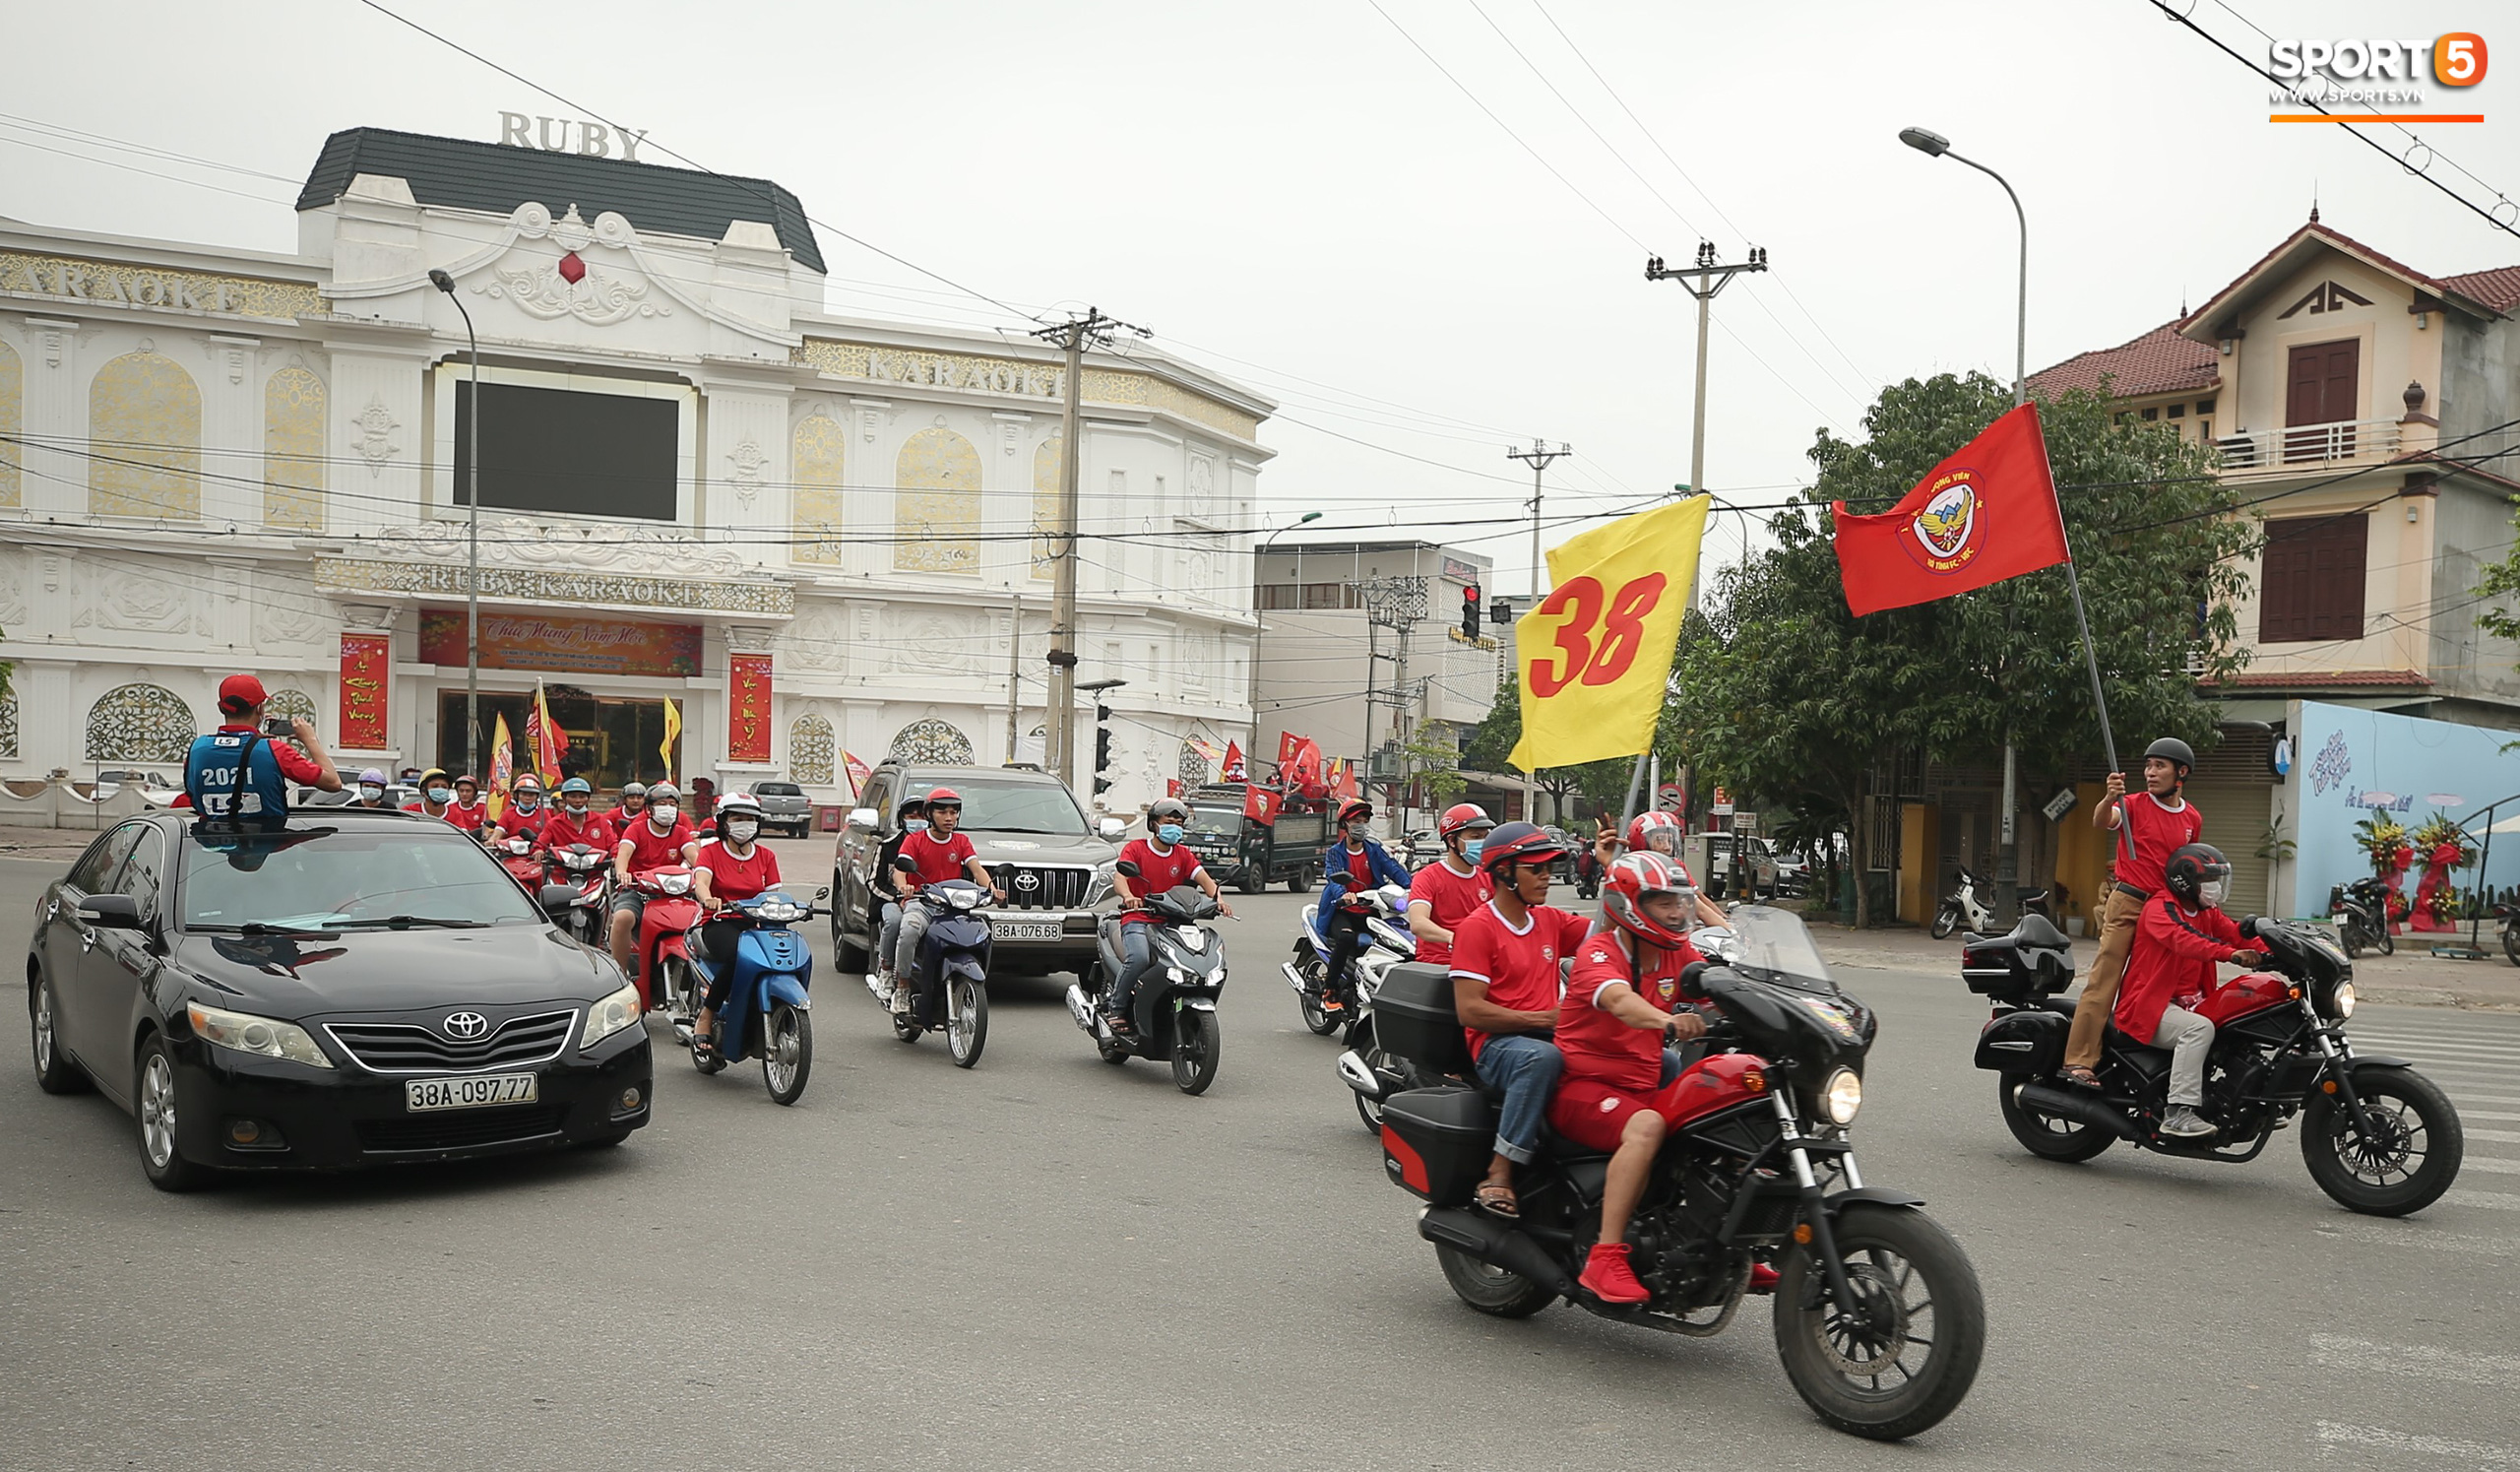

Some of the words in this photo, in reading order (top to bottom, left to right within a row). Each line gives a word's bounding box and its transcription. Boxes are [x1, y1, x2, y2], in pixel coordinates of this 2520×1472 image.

[497, 110, 649, 162] RUBY
[430, 568, 515, 594] RUBY
[539, 575, 700, 605] KARAOKE
[1529, 571, 1668, 698] 38
[202, 767, 253, 787] 2021
[995, 925, 1058, 938] 38A-076.68
[410, 1077, 533, 1108] 38A-097.77
